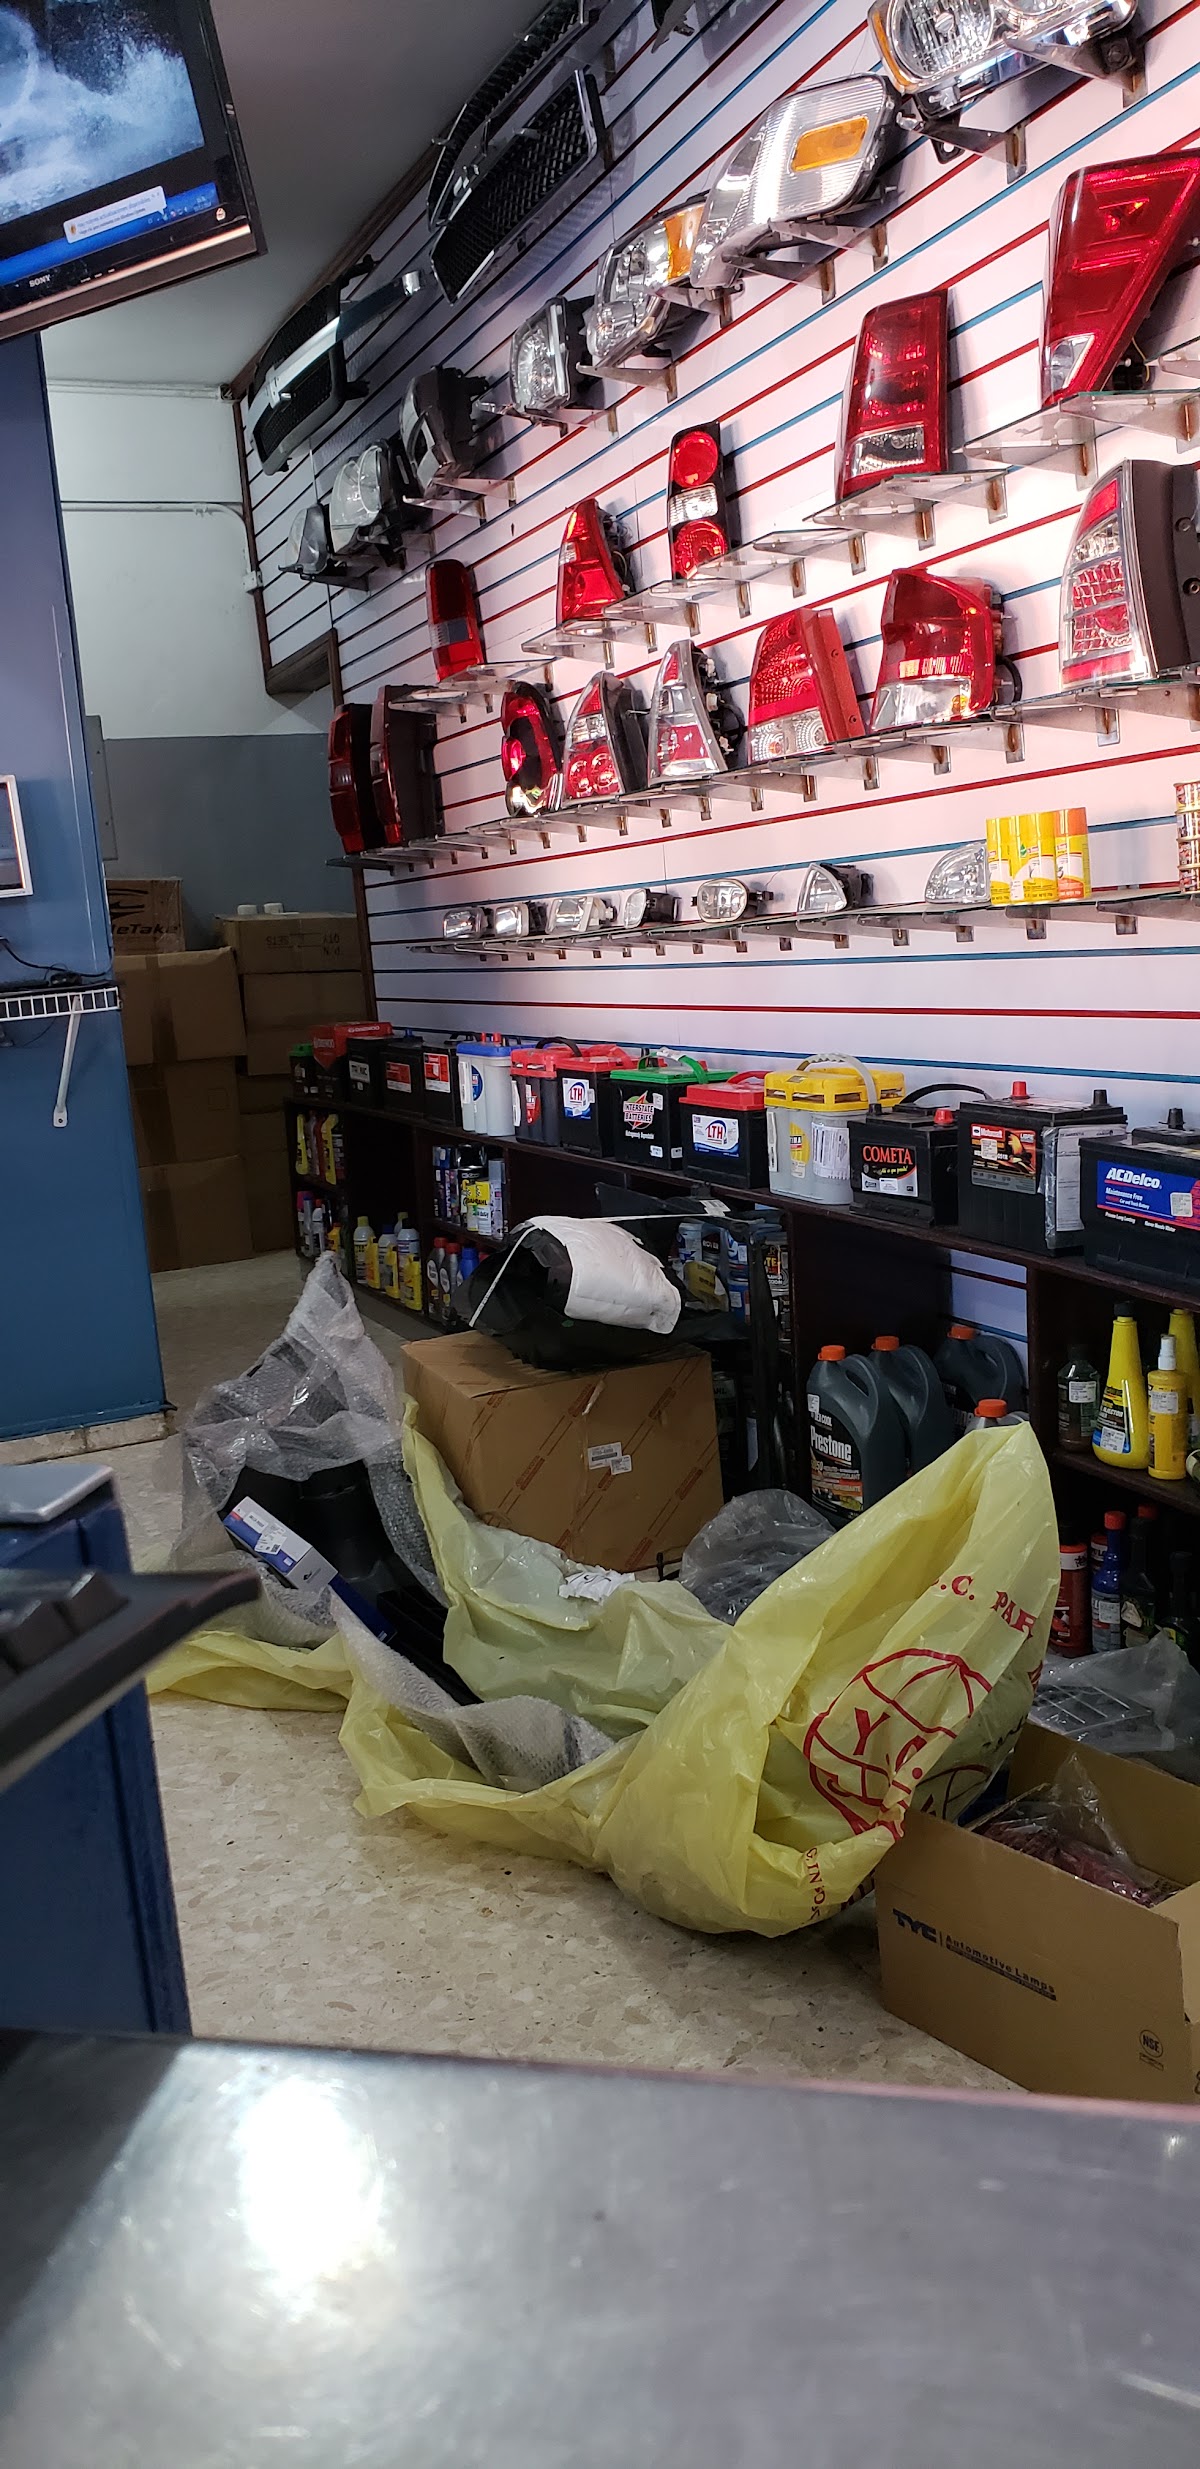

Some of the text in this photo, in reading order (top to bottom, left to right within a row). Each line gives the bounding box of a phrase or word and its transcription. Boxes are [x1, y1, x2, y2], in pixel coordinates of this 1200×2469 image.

[28, 274, 52, 289] SONY
[569, 1087, 584, 1101] LTH
[624, 1102, 655, 1113] INTERSTATE
[624, 1112, 652, 1123] BATTERIES
[706, 1124, 724, 1140] LTH
[862, 1144, 914, 1166] COMETA
[1105, 1167, 1161, 1189] ACDelco
[810, 1425, 852, 1462] Prestone
[892, 1907, 938, 1944] TYC
[946, 1934, 1056, 1994] Automotive Lamps
